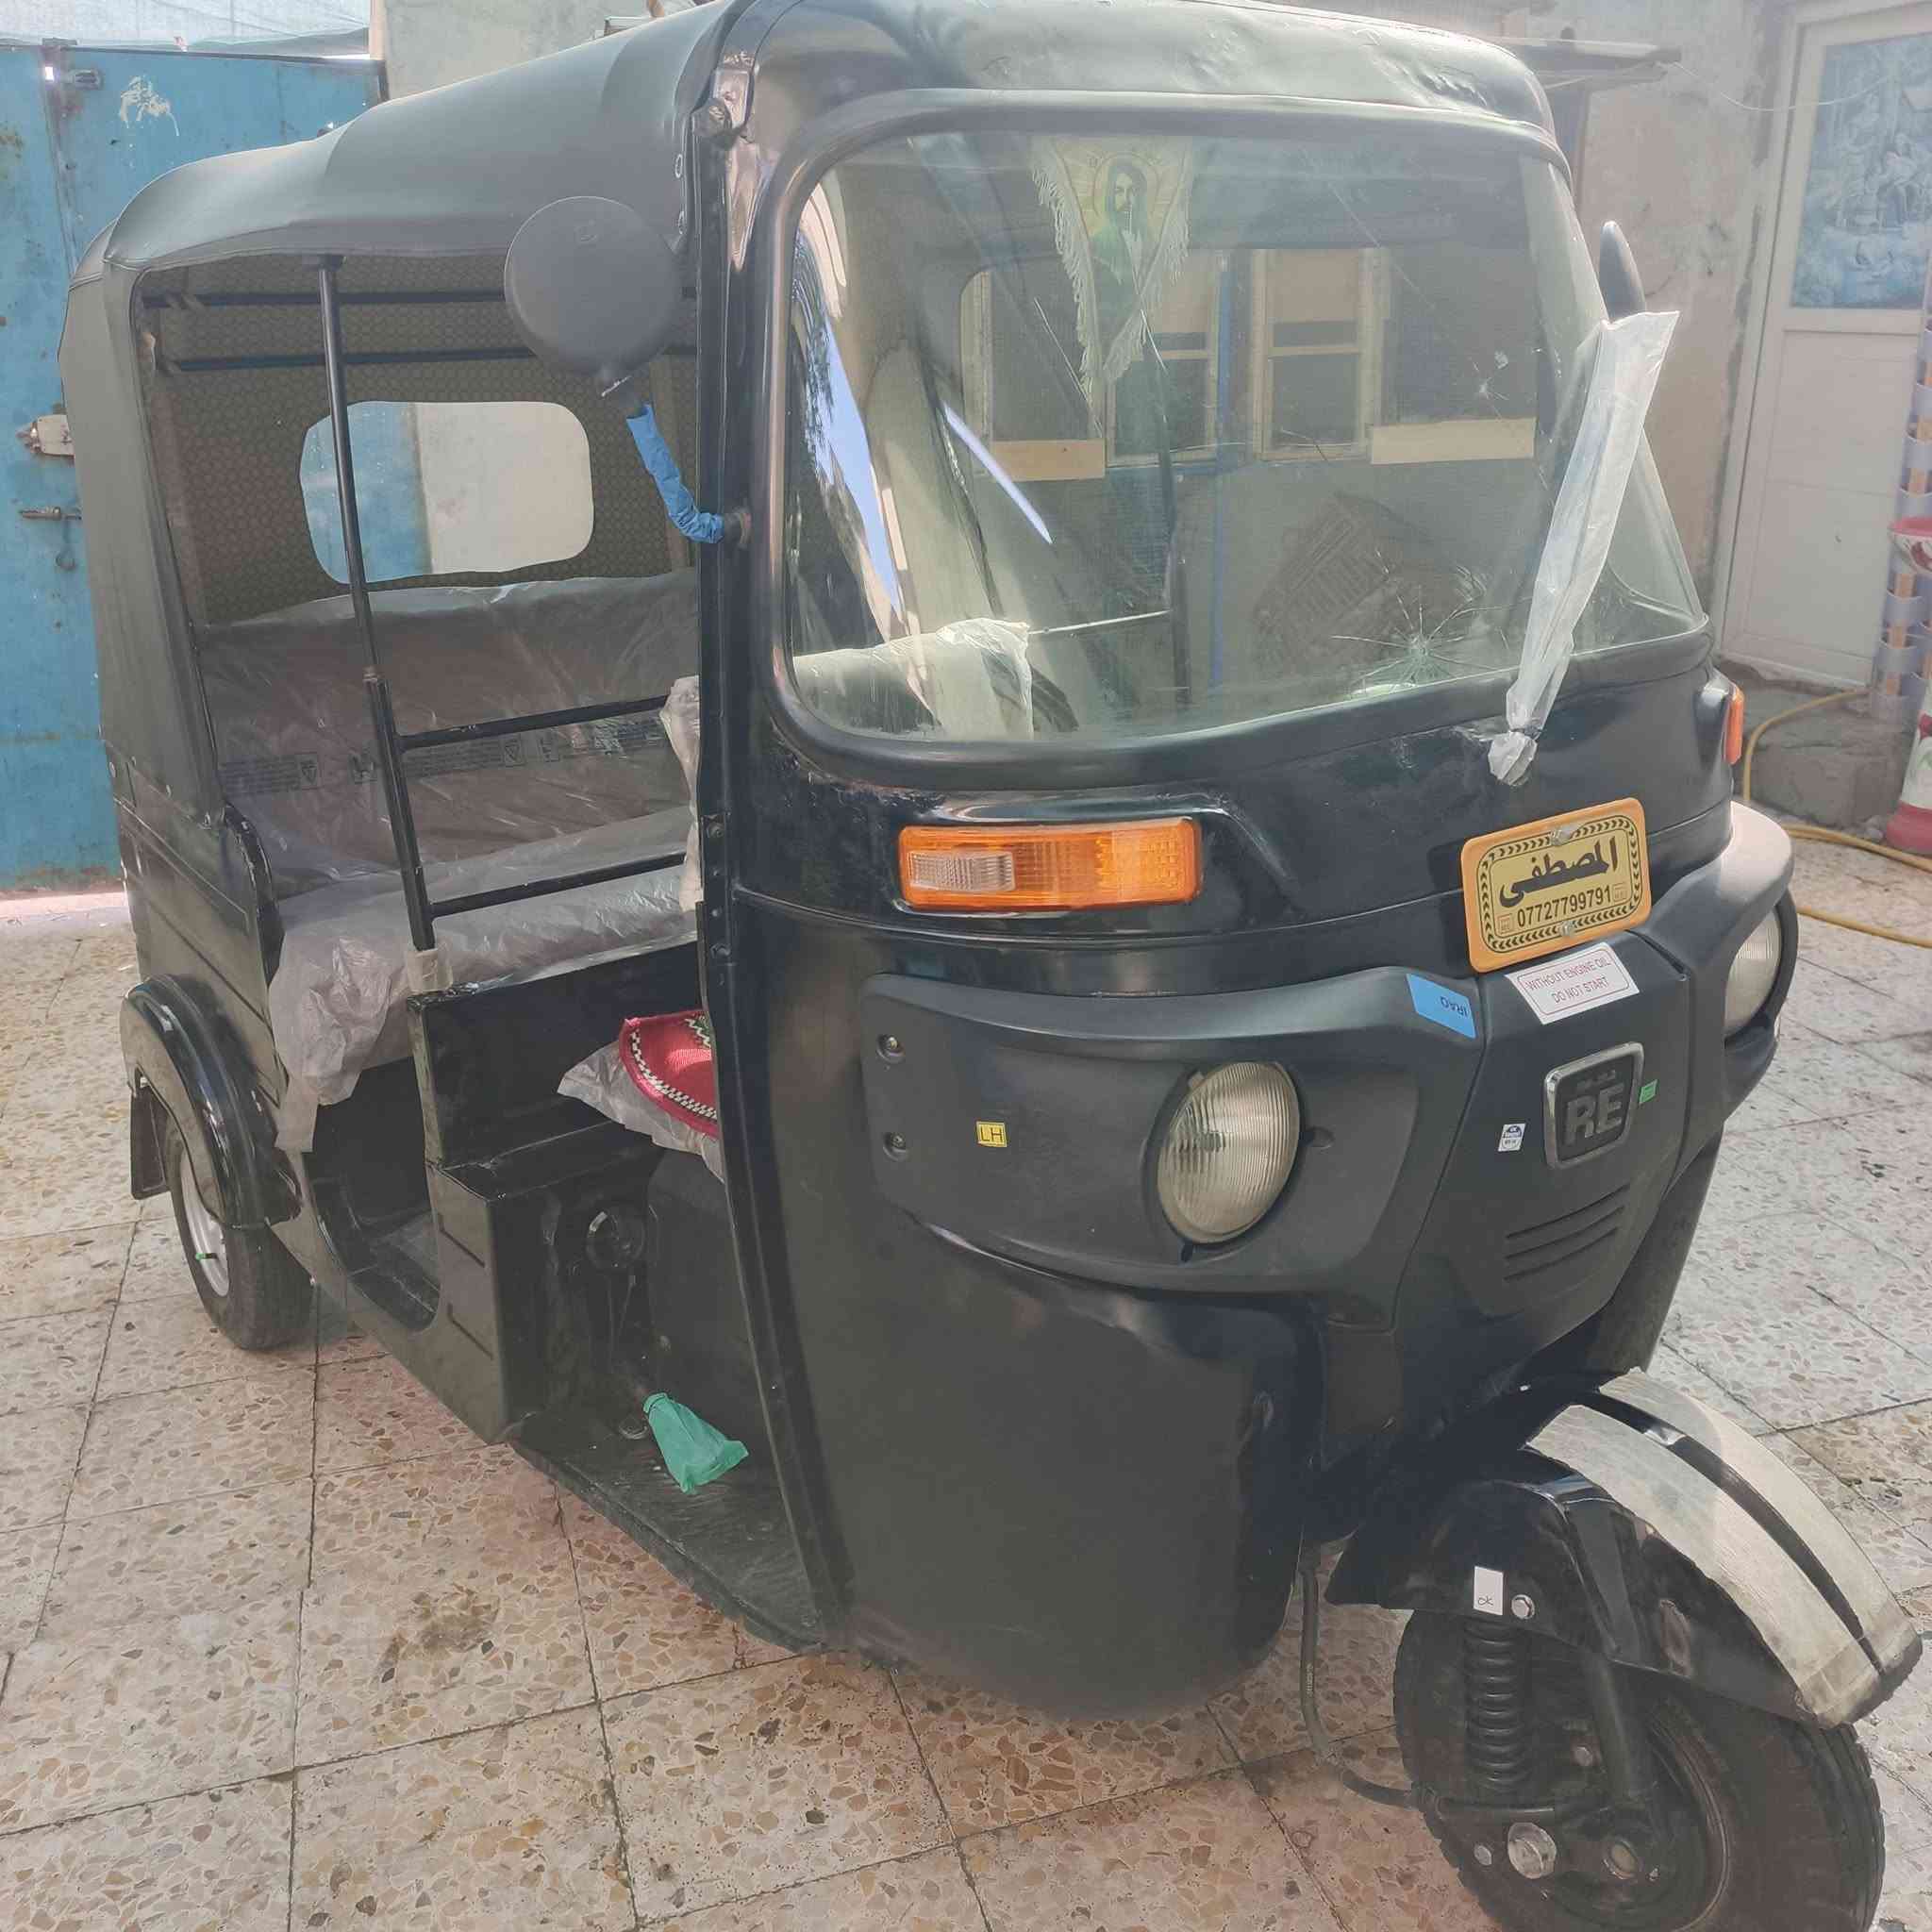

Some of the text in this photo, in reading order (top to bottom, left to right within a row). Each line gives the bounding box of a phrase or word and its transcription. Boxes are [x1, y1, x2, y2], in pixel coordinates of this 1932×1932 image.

[1499, 836, 1618, 908] المصطفى
[1517, 884, 1611, 927] 07727799791
[1524, 957, 1611, 991] WITHOUT ENGINE OIL
[1551, 976, 1608, 1003] DO NOT START
[1566, 1083, 1624, 1145] RE
[980, 1125, 1004, 1142] LH
